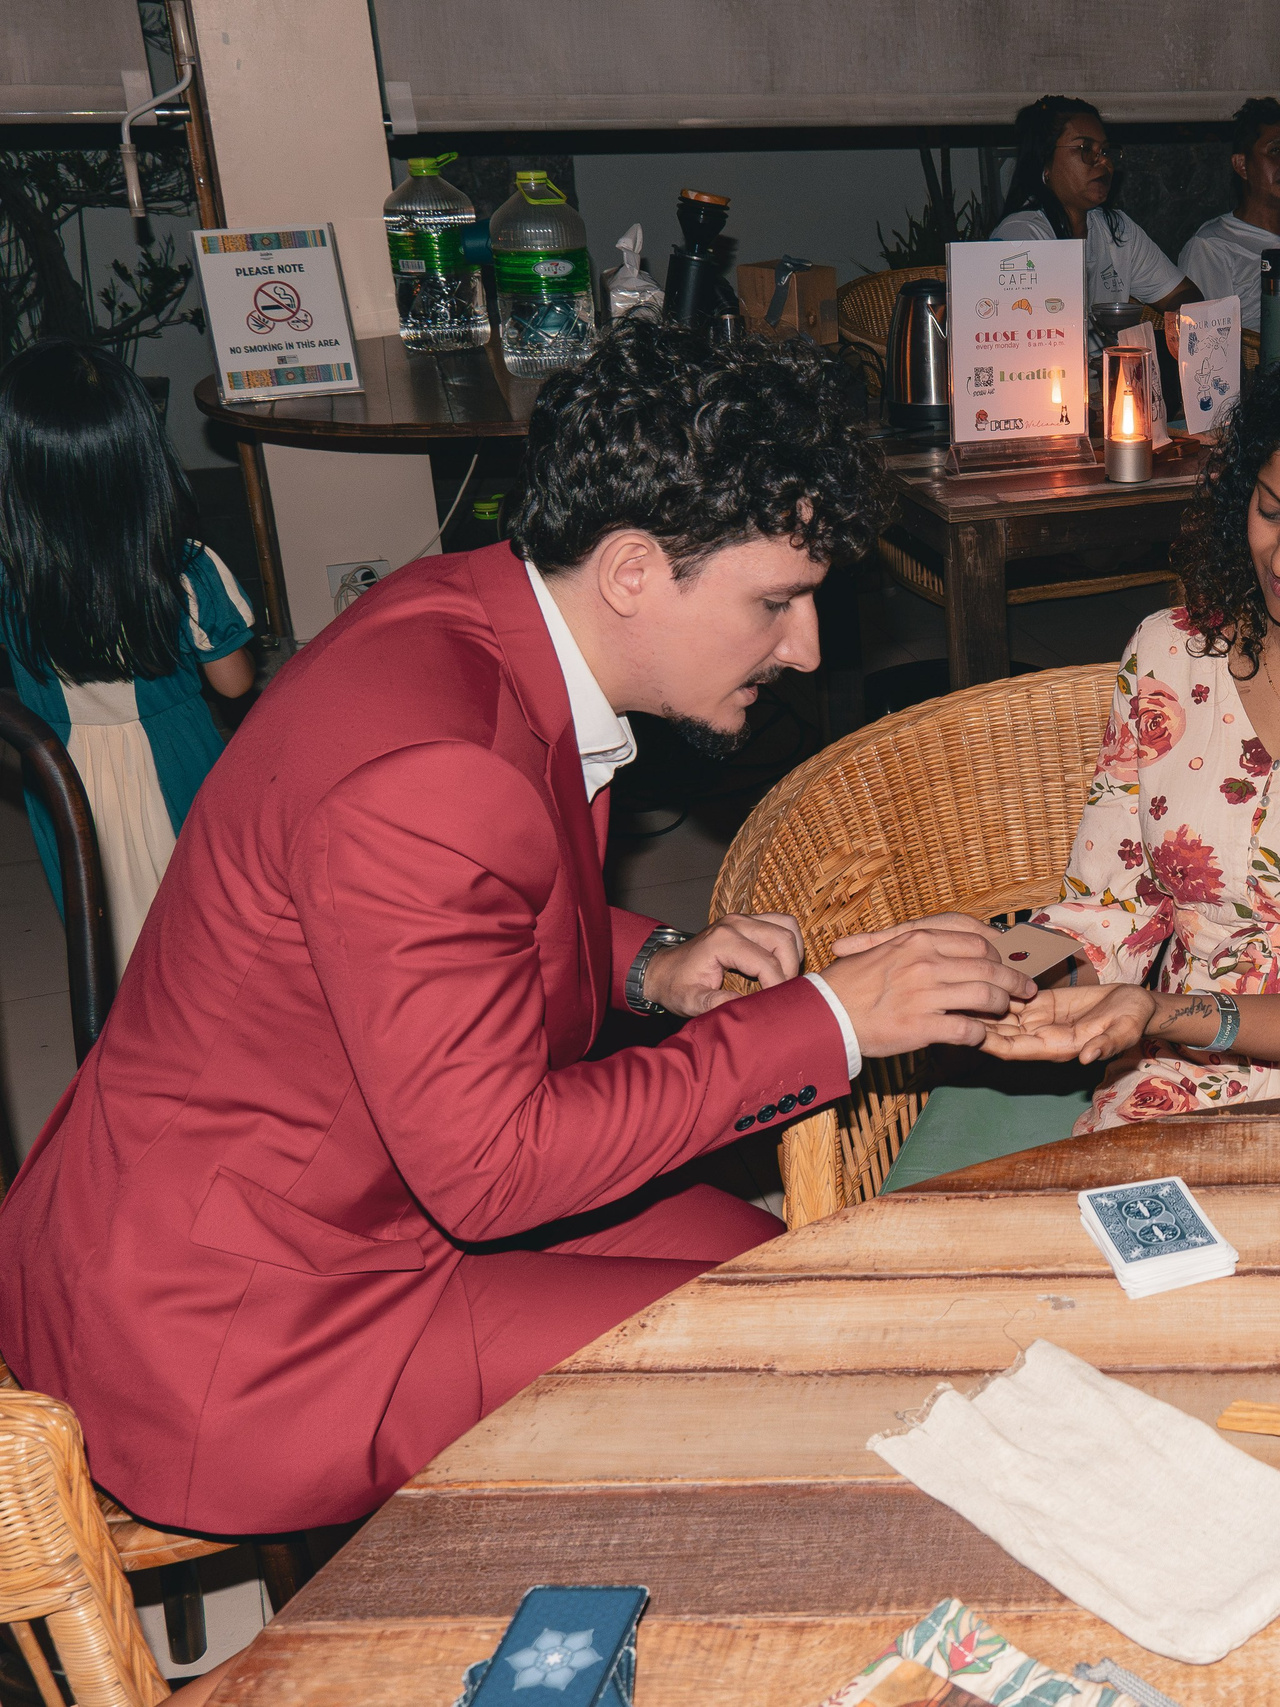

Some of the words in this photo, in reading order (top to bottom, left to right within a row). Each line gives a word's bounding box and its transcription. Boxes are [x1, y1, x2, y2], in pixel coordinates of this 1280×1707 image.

[235, 265, 275, 277] PLEASE
[277, 264, 305, 274] NOTE
[998, 273, 1038, 286] CAFH
[1189, 320, 1208, 330] POUR
[1211, 317, 1232, 327] OVER
[975, 330, 1020, 343] CLOSE
[1026, 328, 1064, 340] OPEN
[229, 346, 242, 354] NO
[318, 338, 340, 348] AREA
[1000, 368, 1066, 382] Location
[990, 418, 1024, 431] PETS
[1228, 1015, 1233, 1024] US
